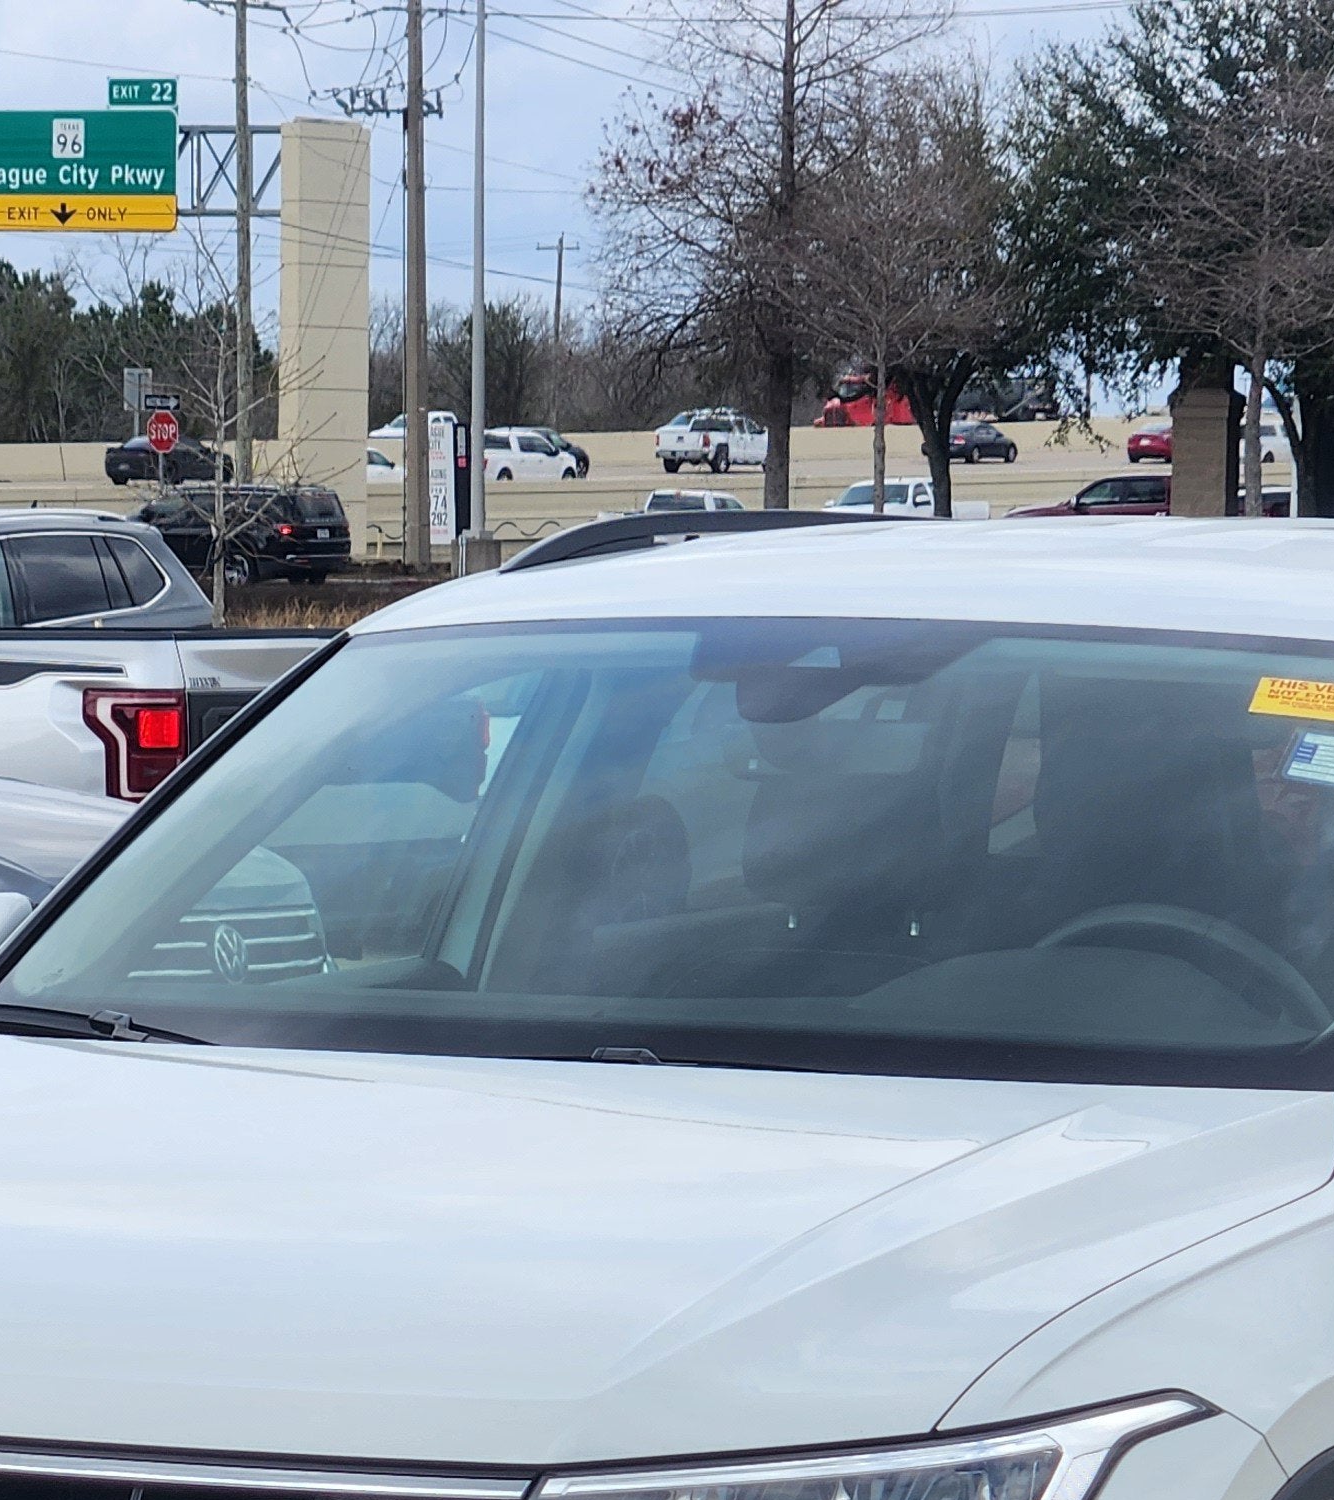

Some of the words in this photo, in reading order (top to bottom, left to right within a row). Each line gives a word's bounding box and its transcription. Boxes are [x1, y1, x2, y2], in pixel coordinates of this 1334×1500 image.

[112, 85, 140, 99] EXIT
[151, 83, 173, 101] 22
[59, 123, 80, 131] TEXAS
[57, 133, 82, 154] 96
[59, 163, 99, 189] City
[111, 163, 166, 190] Pkwy
[7, 206, 40, 220] EXIT
[87, 206, 128, 221] ONLY
[149, 423, 176, 441] STOP
[1269, 678, 1309, 691] THIS
[1269, 688, 1298, 697] NOT
